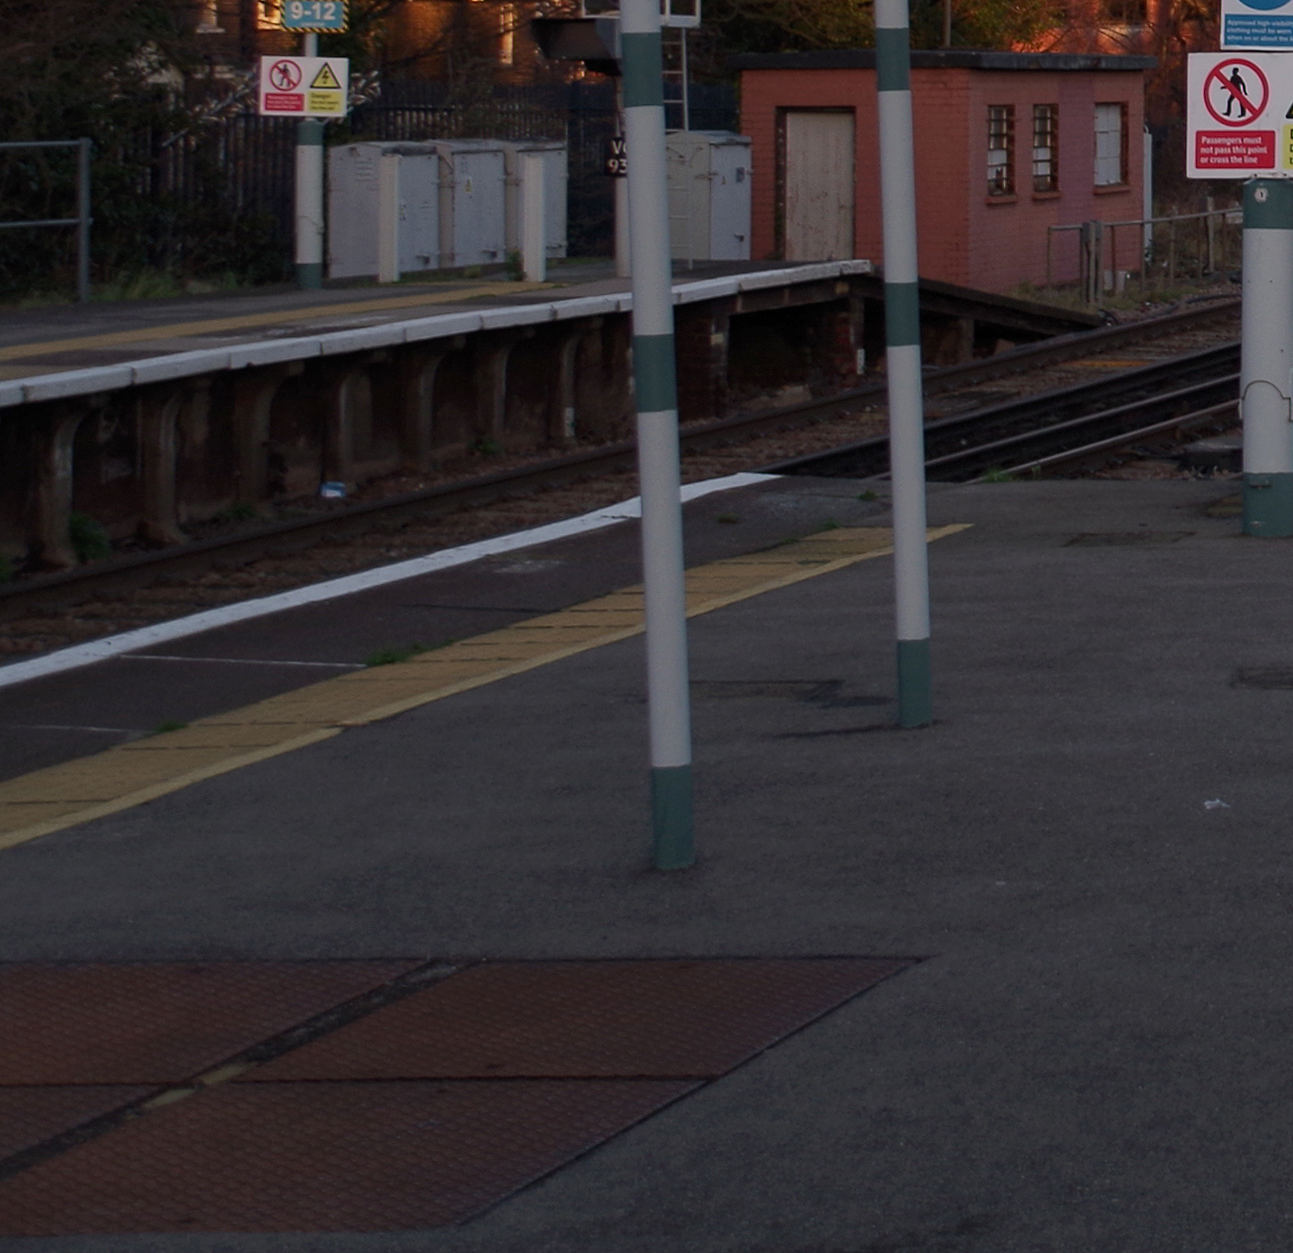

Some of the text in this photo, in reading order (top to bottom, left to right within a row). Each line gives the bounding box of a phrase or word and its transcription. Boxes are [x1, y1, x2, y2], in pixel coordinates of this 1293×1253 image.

[291, 2, 336, 20] 9-12
[1201, 136, 1242, 145] Passengers
[1200, 146, 1268, 155] not pass this point
[1230, 156, 1243, 164] the
[1244, 156, 1258, 164] line
